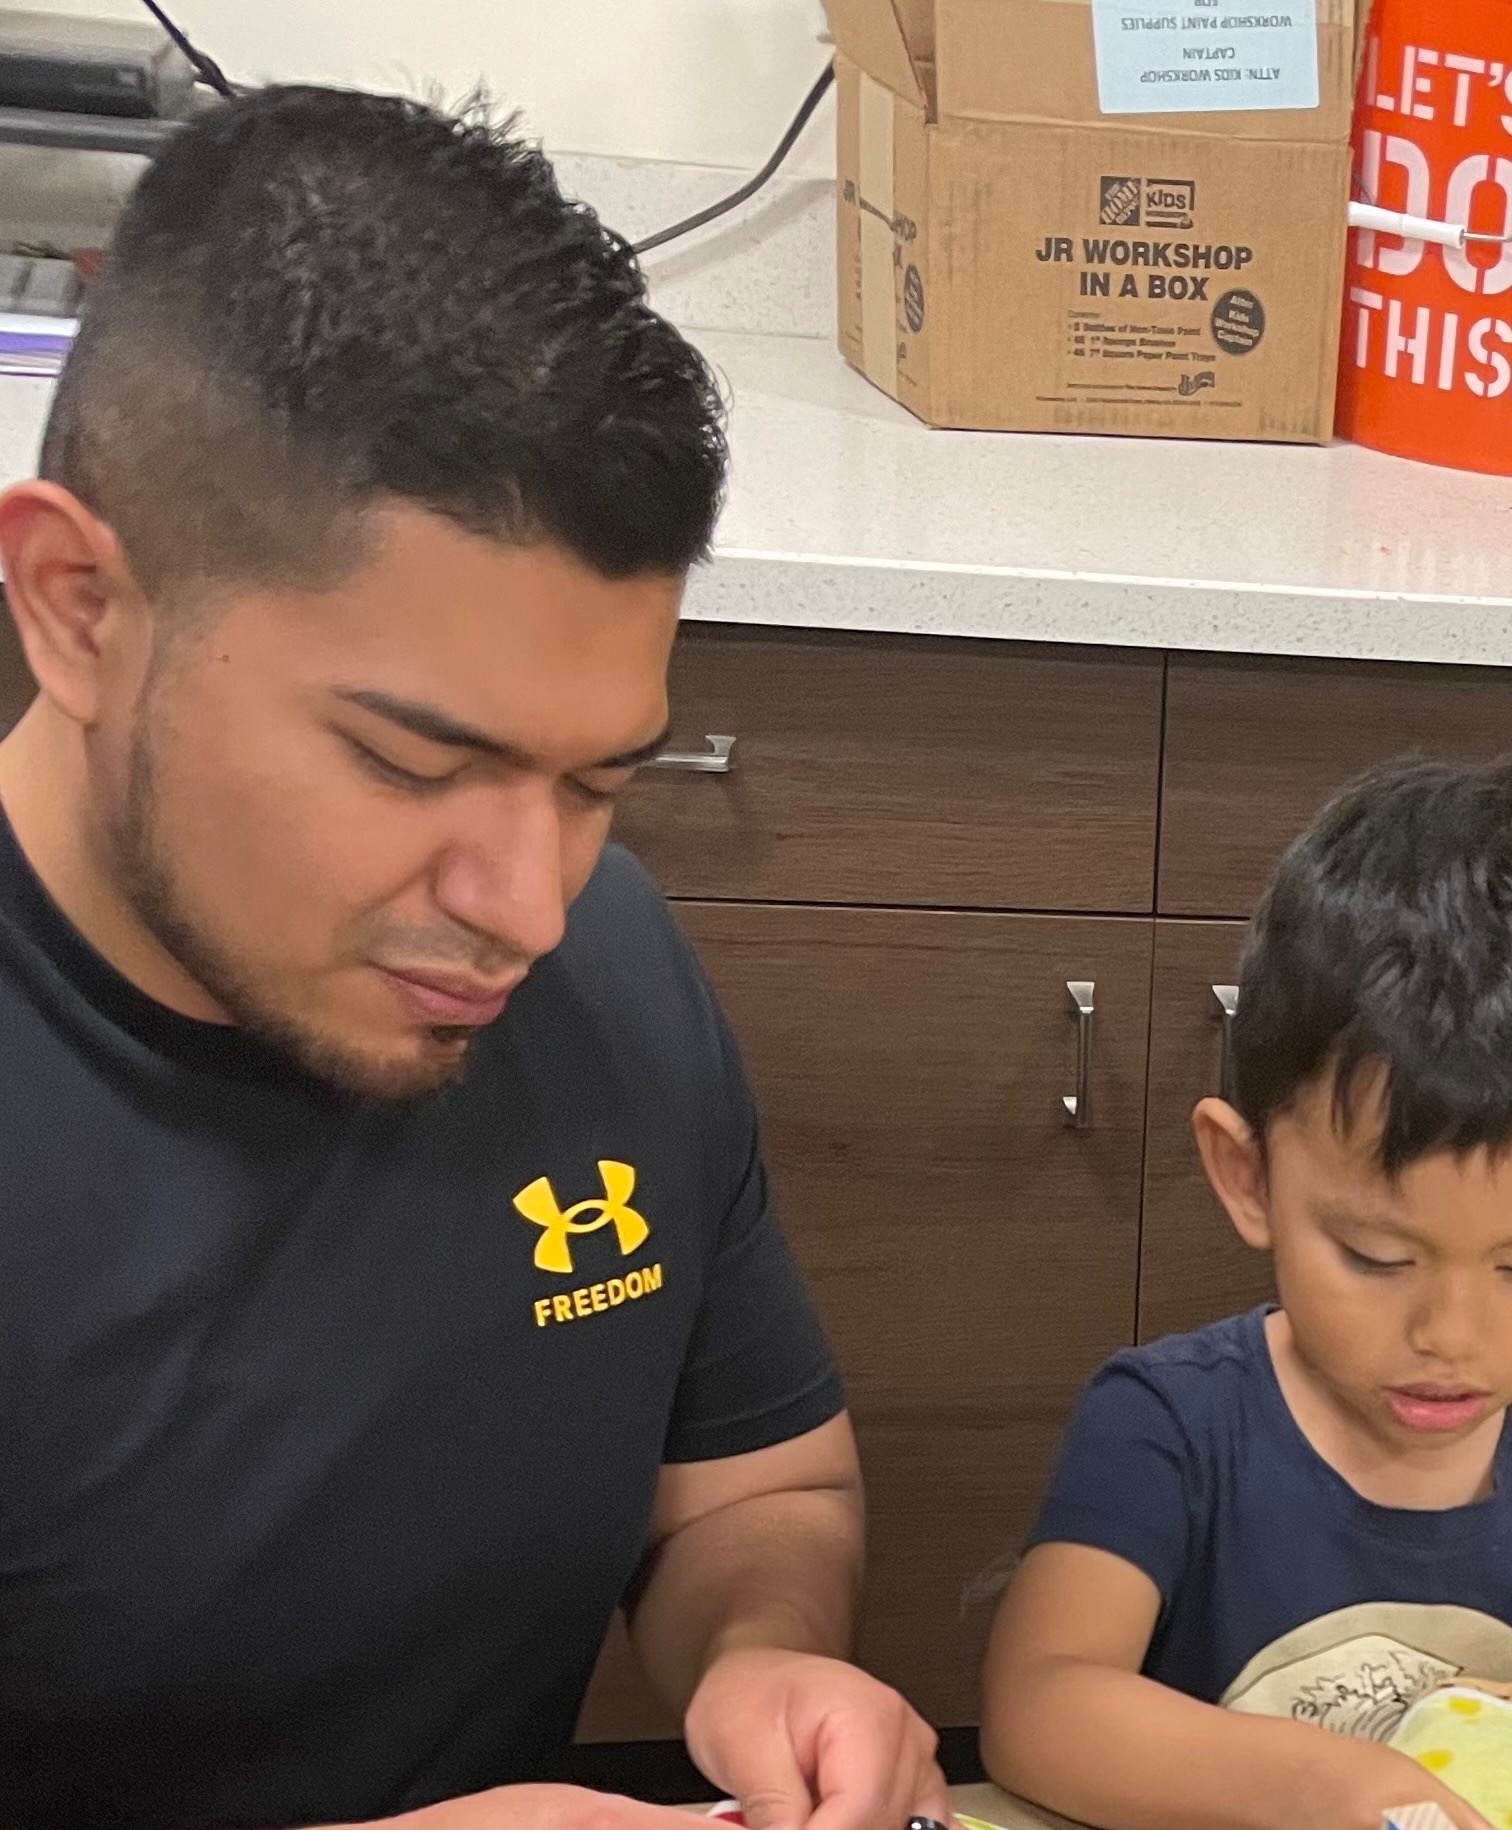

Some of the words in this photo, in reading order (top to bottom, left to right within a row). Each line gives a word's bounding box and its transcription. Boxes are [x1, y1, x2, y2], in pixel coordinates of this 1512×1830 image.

[1121, 17, 1177, 30] SUPPLIES
[1182, 16, 1217, 29] PAINT
[1220, 16, 1292, 27] WORKSHOP
[1183, 47, 1235, 59] CAPTAIN
[1140, 69, 1211, 82] WORKSHOP
[1215, 68, 1241, 81] KIDS
[1147, 190, 1187, 210] KIDS
[1035, 237, 1074, 263] JR
[1082, 238, 1253, 270] WORKSHOP
[1080, 272, 1110, 296] IN
[1119, 274, 1139, 298] A
[1148, 275, 1210, 301] BOX
[534, 1263, 663, 1326] FREEDOM
